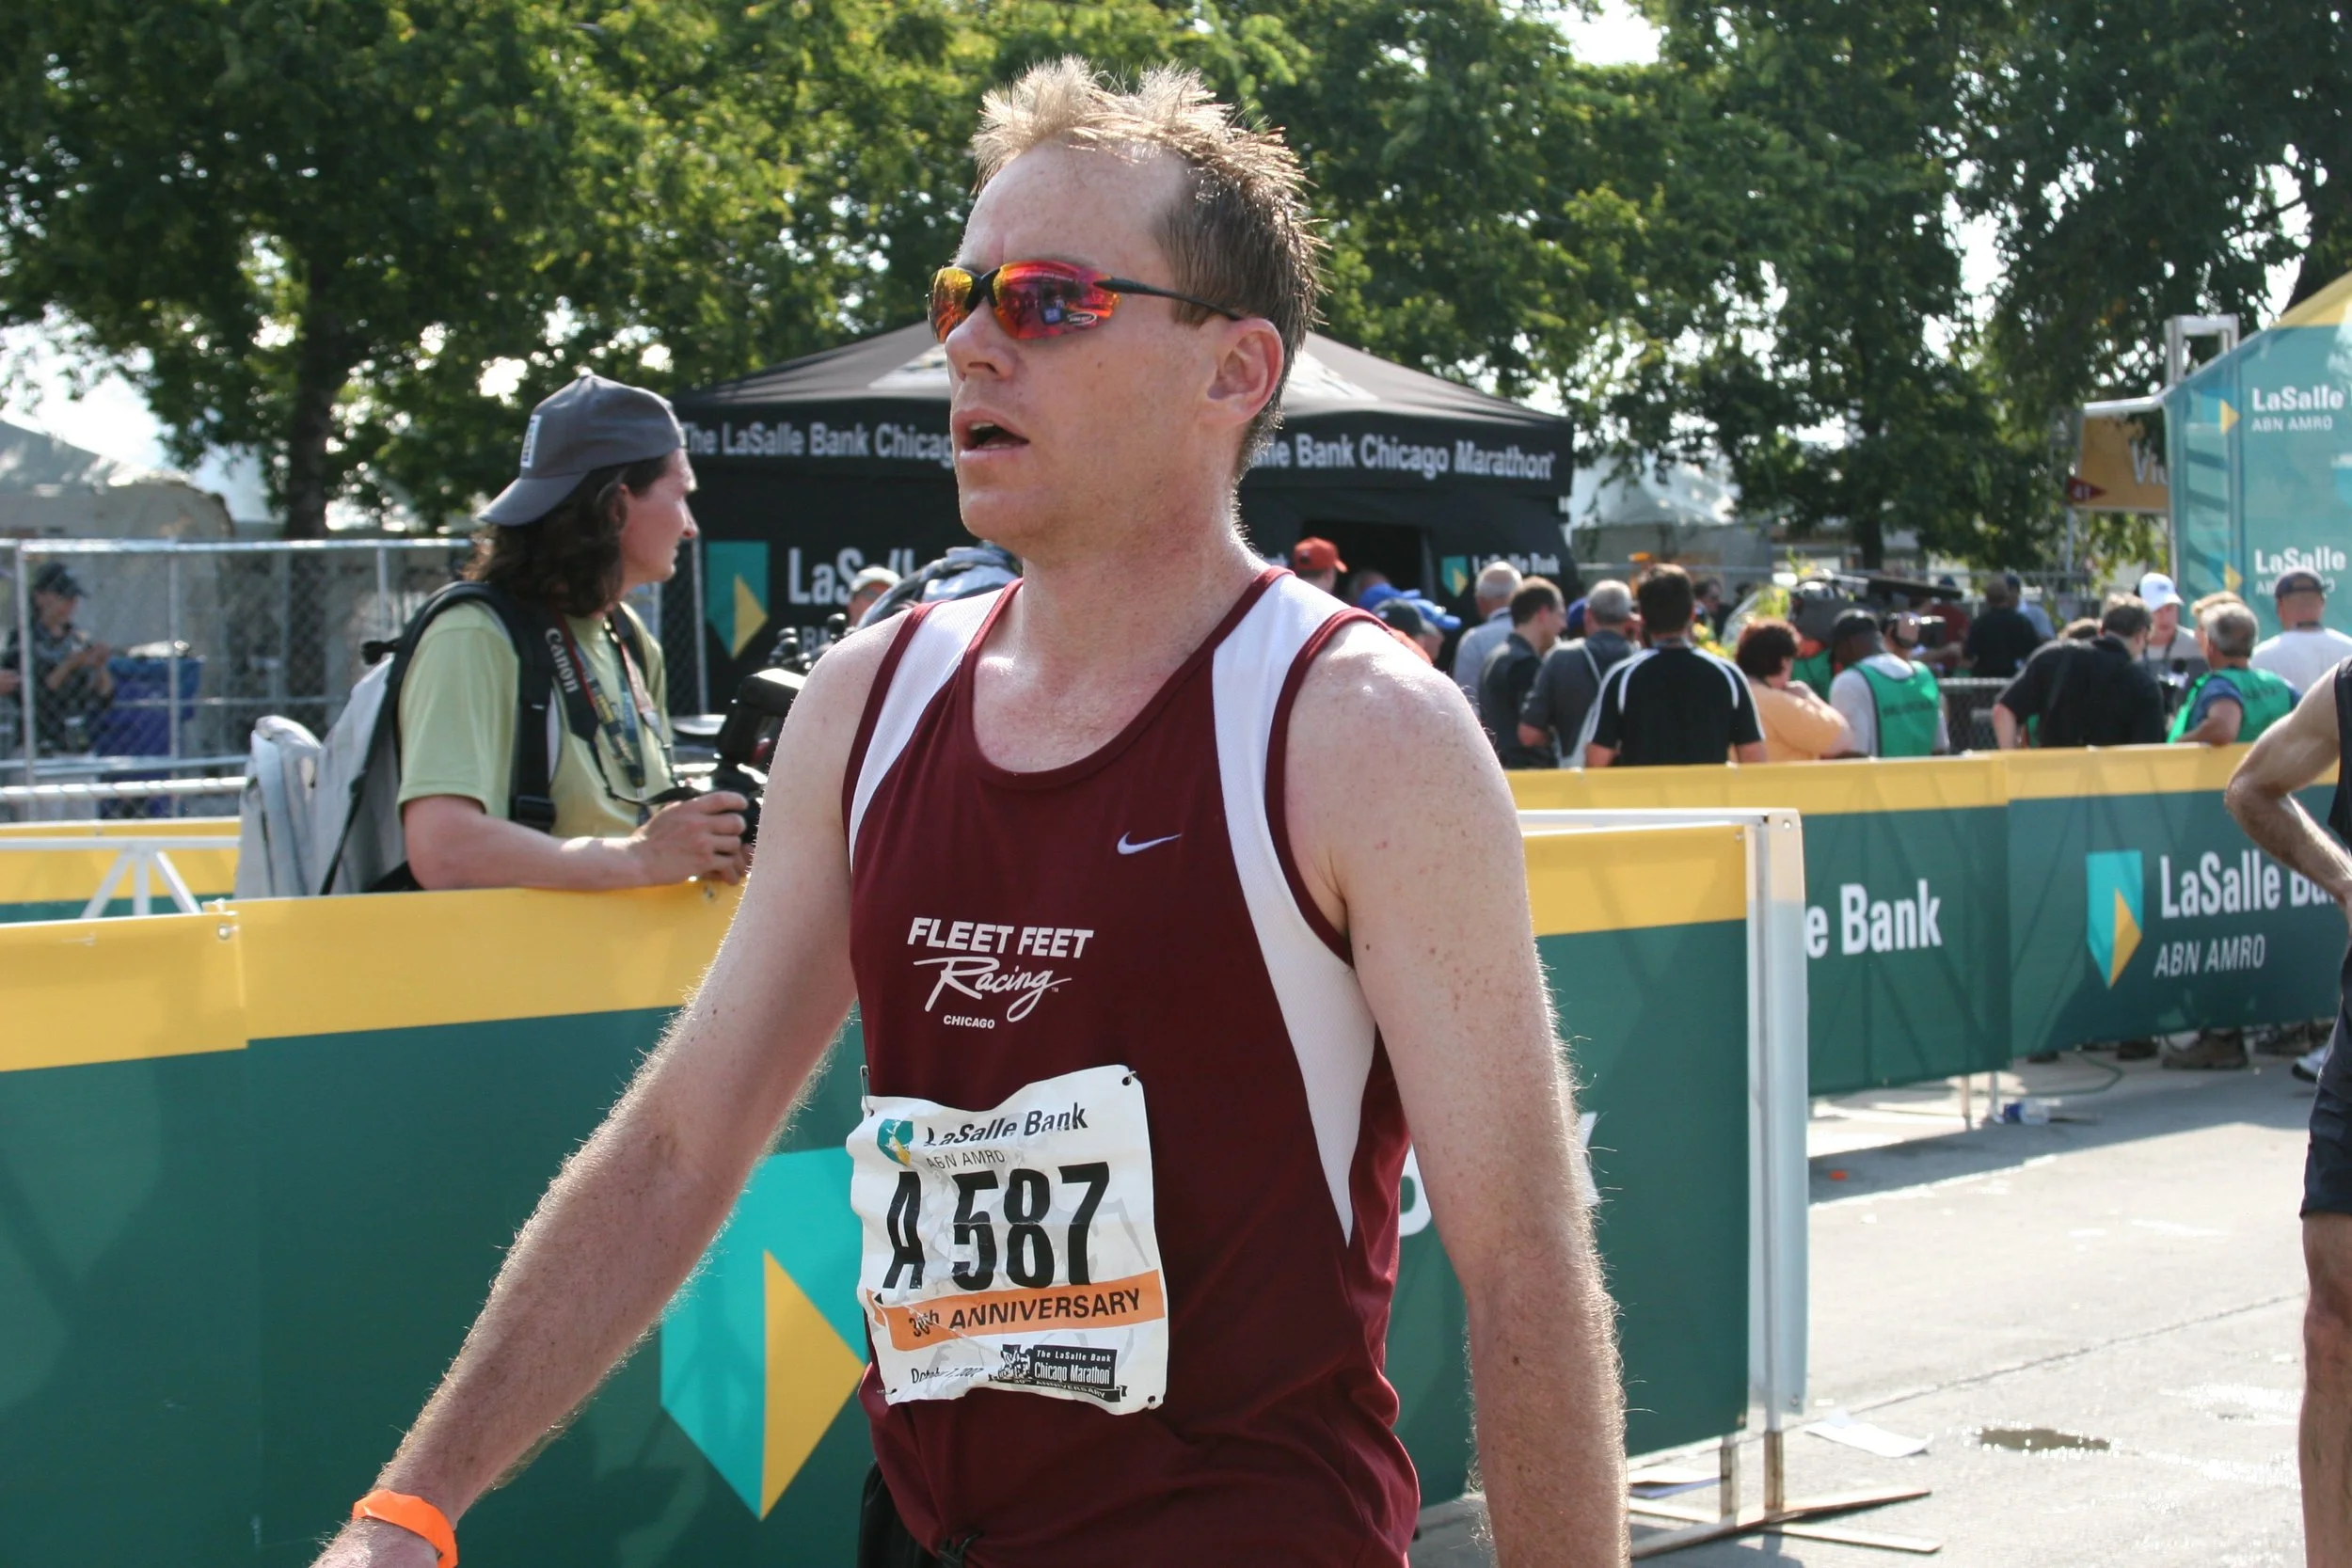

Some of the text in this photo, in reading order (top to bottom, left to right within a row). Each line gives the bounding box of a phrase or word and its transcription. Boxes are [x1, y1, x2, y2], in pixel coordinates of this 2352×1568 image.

[2251, 385, 2344, 412] LaSalle
[723, 421, 804, 455] LaSalle
[810, 422, 869, 456] Bank
[875, 422, 954, 468] Chicag
[1295, 433, 1356, 468] Bank
[1359, 434, 1450, 480] Chicago
[545, 627, 580, 693] Canon
[2160, 848, 2280, 919] LaSalle
[907, 917, 1094, 958] FLEET FEET
[1840, 878, 1943, 956] Bank
[2153, 933, 2266, 978] ABN AMRO
[914, 956, 1072, 1022] Racing
[943, 1015, 995, 1029] CHICAGO
[924, 1101, 1089, 1146] LaSalle Bank
[882, 1161, 1110, 1291] A 587
[949, 1287, 1140, 1330] ANNIVERSARY
[1034, 1361, 1068, 1383] Chicago
[1037, 1349, 1111, 1363] The LaSalle Bank
